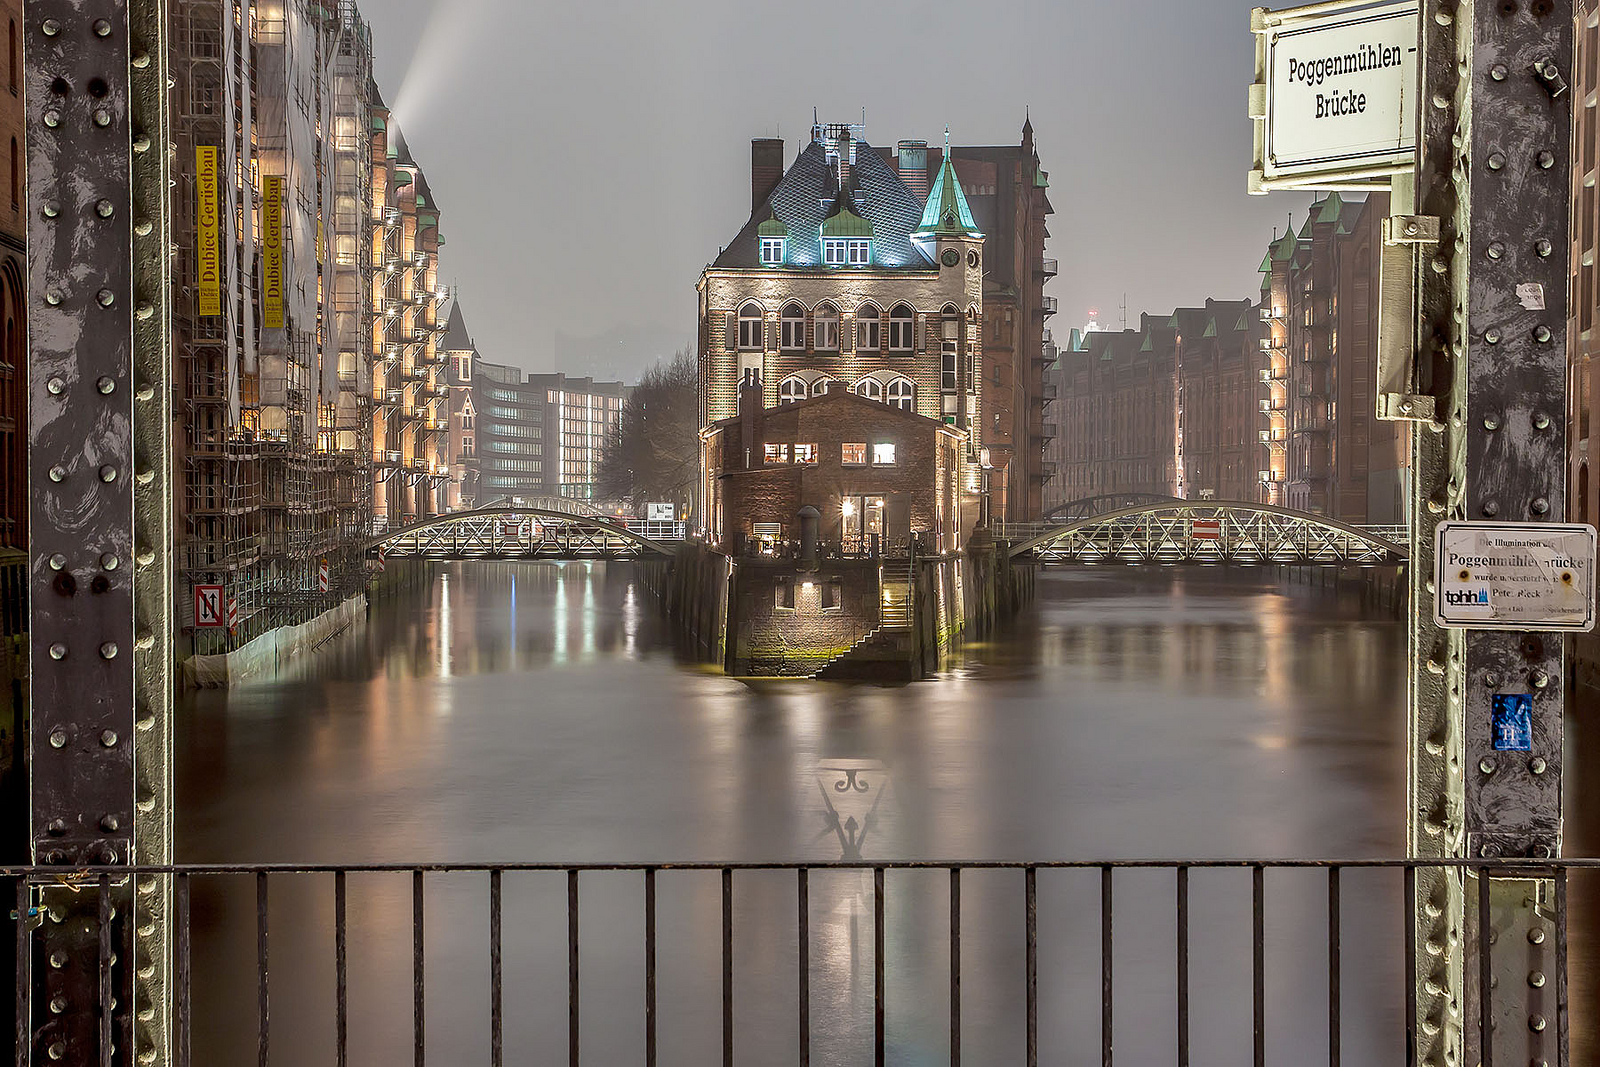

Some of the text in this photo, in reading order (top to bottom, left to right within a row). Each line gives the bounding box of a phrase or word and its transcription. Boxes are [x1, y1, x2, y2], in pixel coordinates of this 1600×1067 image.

[1289, 43, 1402, 86] Poggenmühlen
[1315, 90, 1366, 118] Brücke
[200, 150, 215, 227] Gerüstbau
[266, 178, 279, 250] Gerüstbau
[201, 232, 216, 282] Dubiec
[267, 253, 280, 298] Dubiec
[1495, 539, 1541, 548] Illumination
[1445, 590, 1478, 606] tphh
[1474, 573, 1498, 582] wurde
